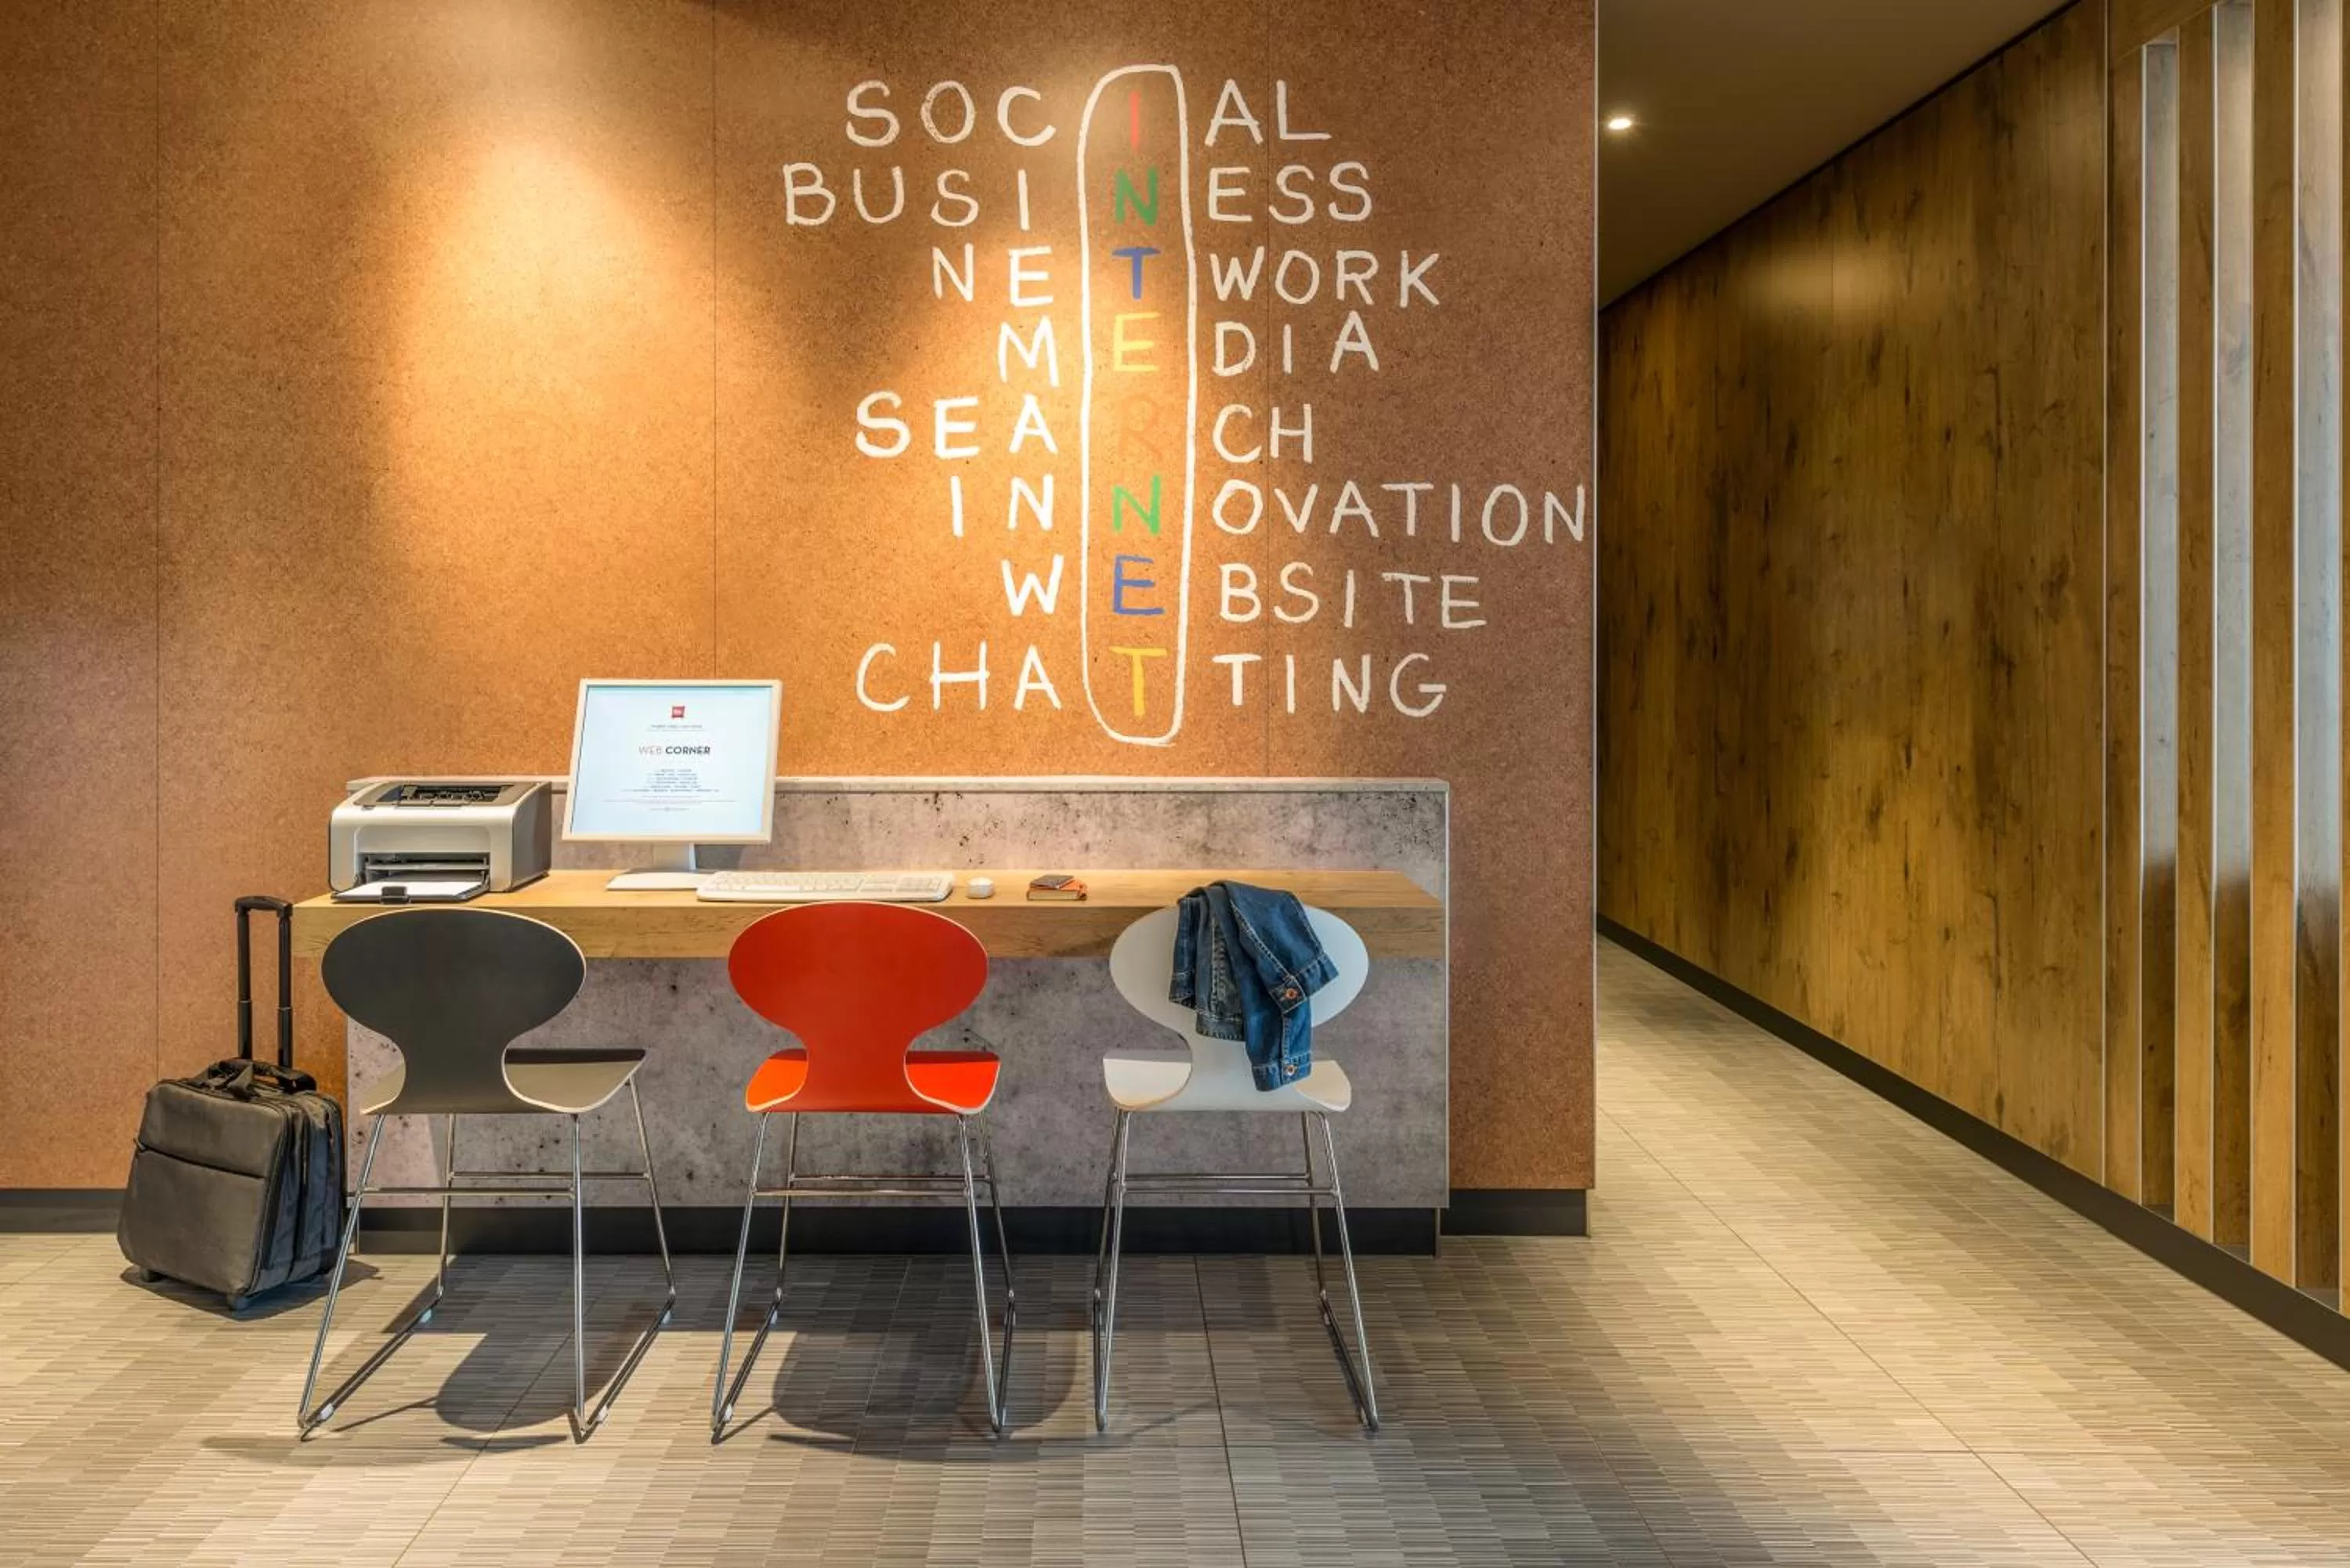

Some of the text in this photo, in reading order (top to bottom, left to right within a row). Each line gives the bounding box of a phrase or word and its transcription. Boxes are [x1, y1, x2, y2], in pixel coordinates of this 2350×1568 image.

[844, 80, 1332, 149] SOCIAL
[783, 162, 1373, 231] BUSINESS
[931, 244, 1441, 308] NETWORK
[997, 310, 1379, 386] MEDIA
[855, 391, 1313, 462] SEARCH
[950, 475, 1586, 545] INNOVATION
[1001, 555, 1486, 628] WEBSITE
[855, 643, 1446, 717] CHATTING
[638, 745, 711, 755] WEB CORNER
